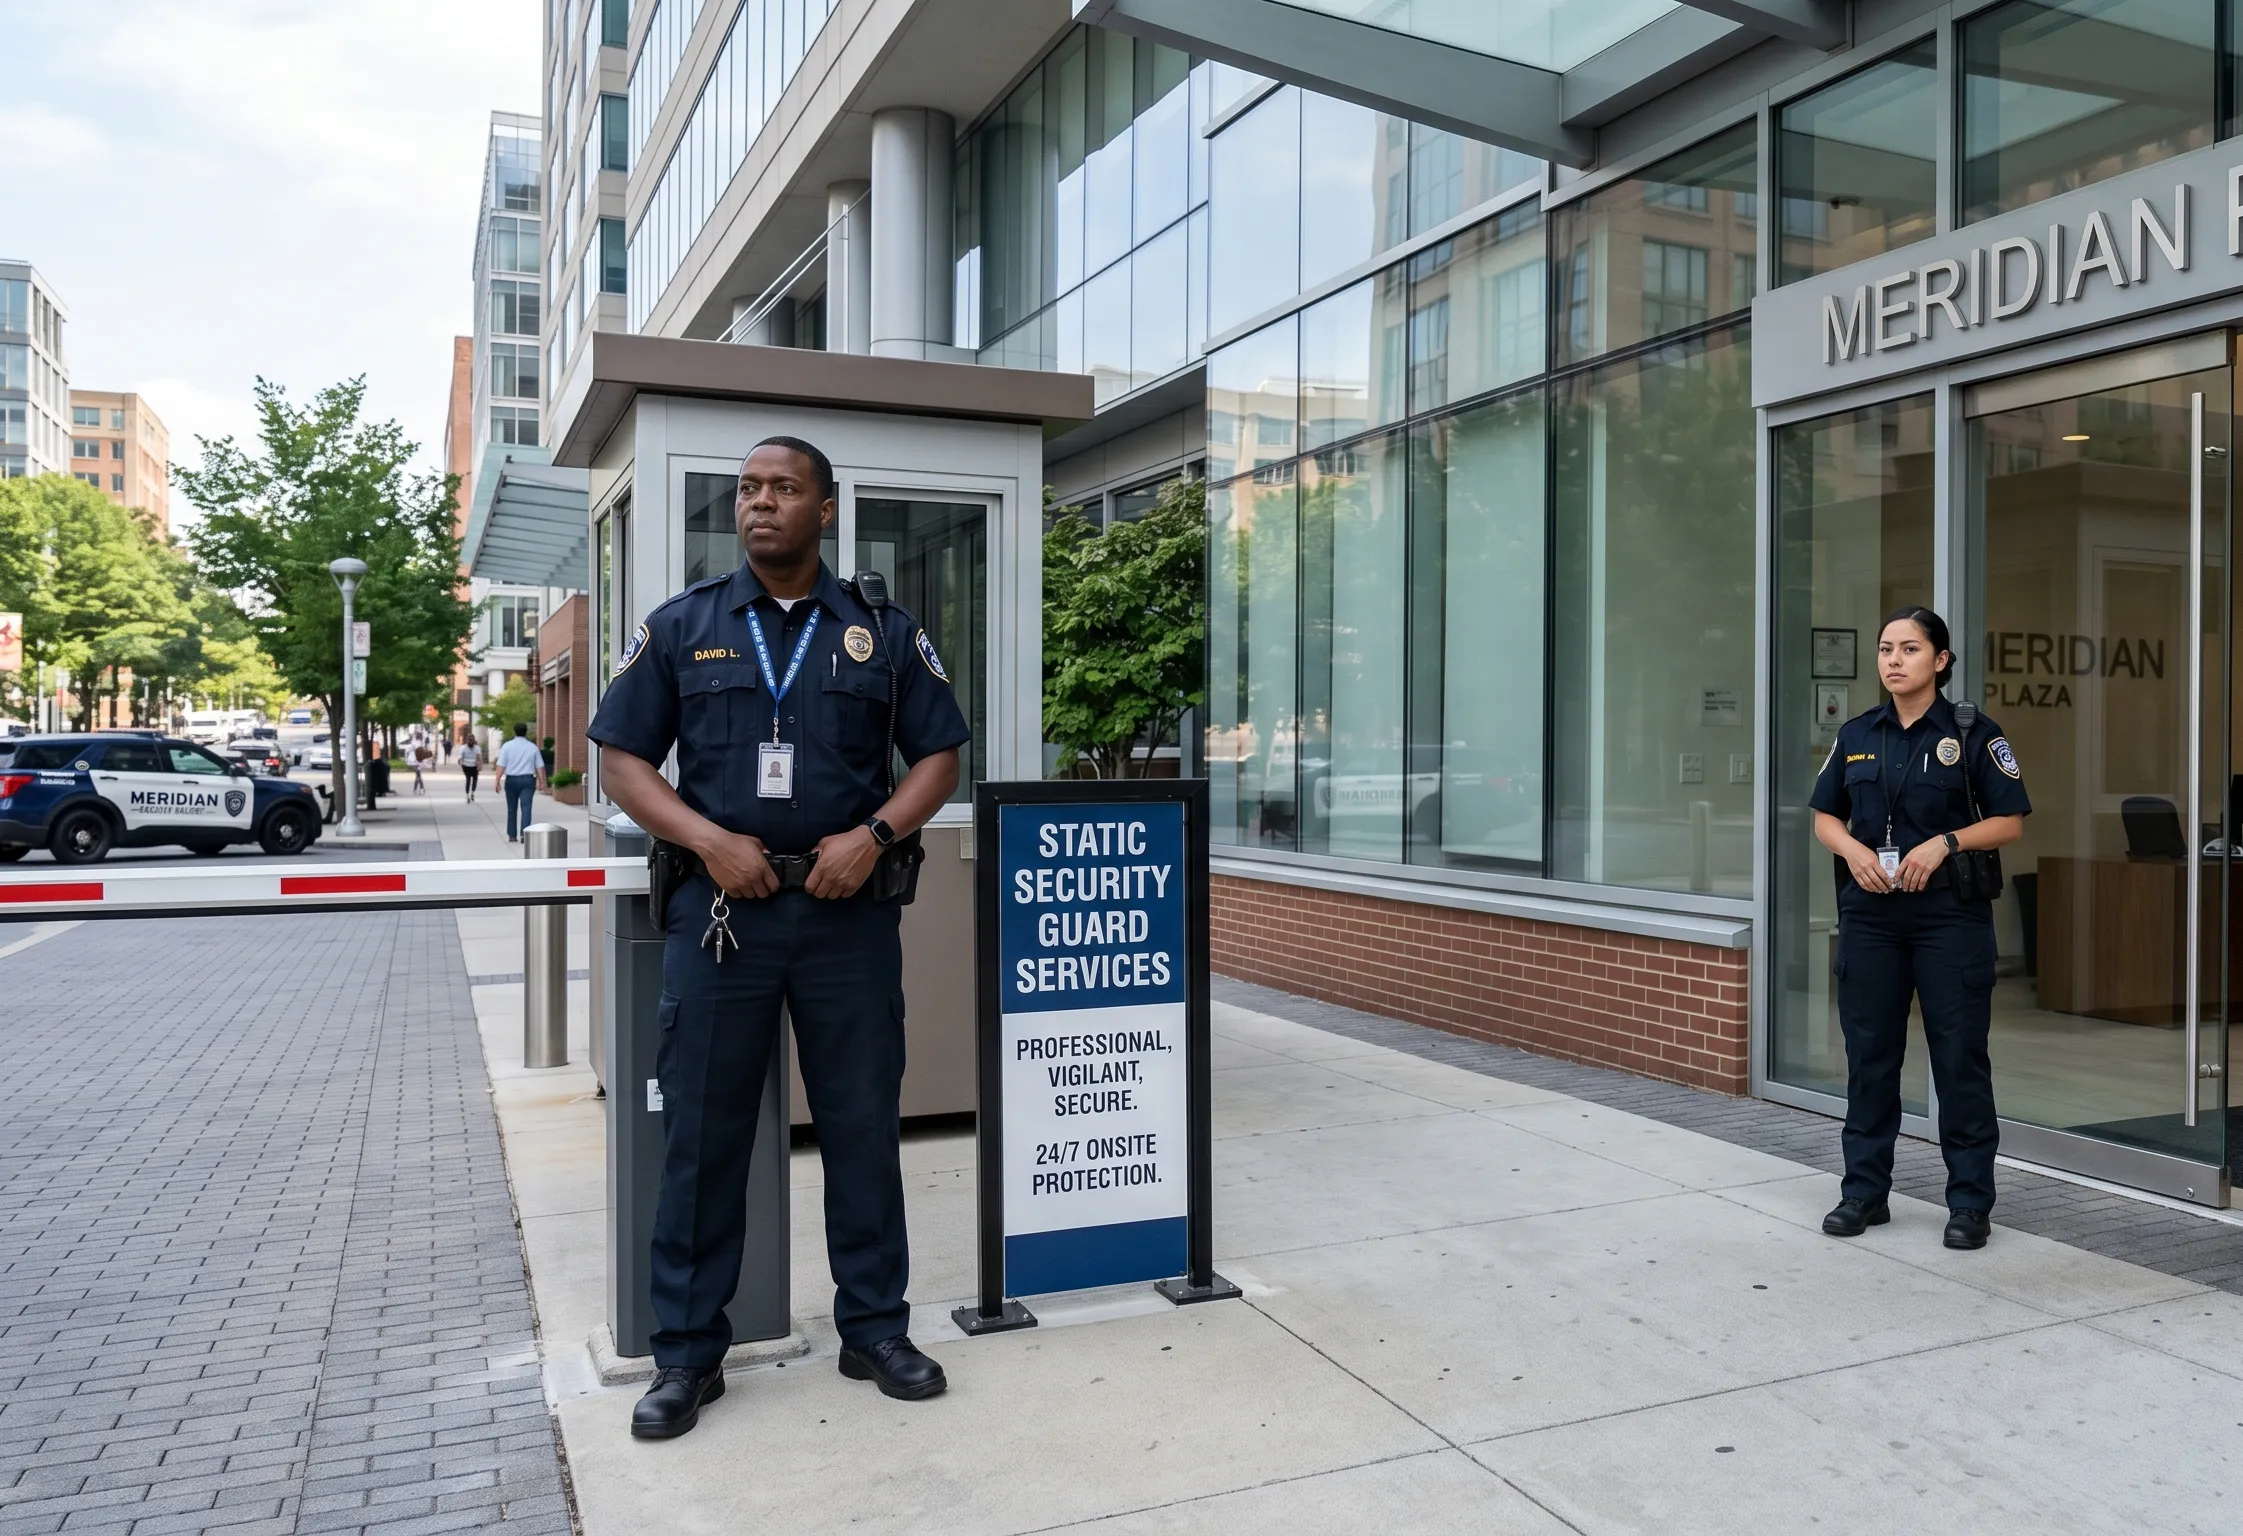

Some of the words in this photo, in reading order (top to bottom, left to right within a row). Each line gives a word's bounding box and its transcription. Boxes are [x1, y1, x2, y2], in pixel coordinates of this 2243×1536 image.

[1823, 184, 2190, 366] MERIDIAN
[694, 649, 727, 661] DAVID
[729, 648, 740, 658] L.
[1984, 683, 2072, 708] PLAZA
[130, 791, 218, 806] MERIDIAN
[1039, 821, 1146, 857] STATIC
[1014, 864, 1172, 904] SECURITY
[1038, 910, 1149, 947] GUARD
[1016, 951, 1171, 994] SERVICES
[1017, 1030, 1172, 1060] PROFESSIONAL,
[1048, 1060, 1143, 1087] VIGILANT,
[1054, 1089, 1138, 1117] SECURE.
[1036, 1141, 1080, 1165] 24/7
[1086, 1133, 1157, 1161] ONSITE
[1032, 1163, 1162, 1195] PROTECTION.
